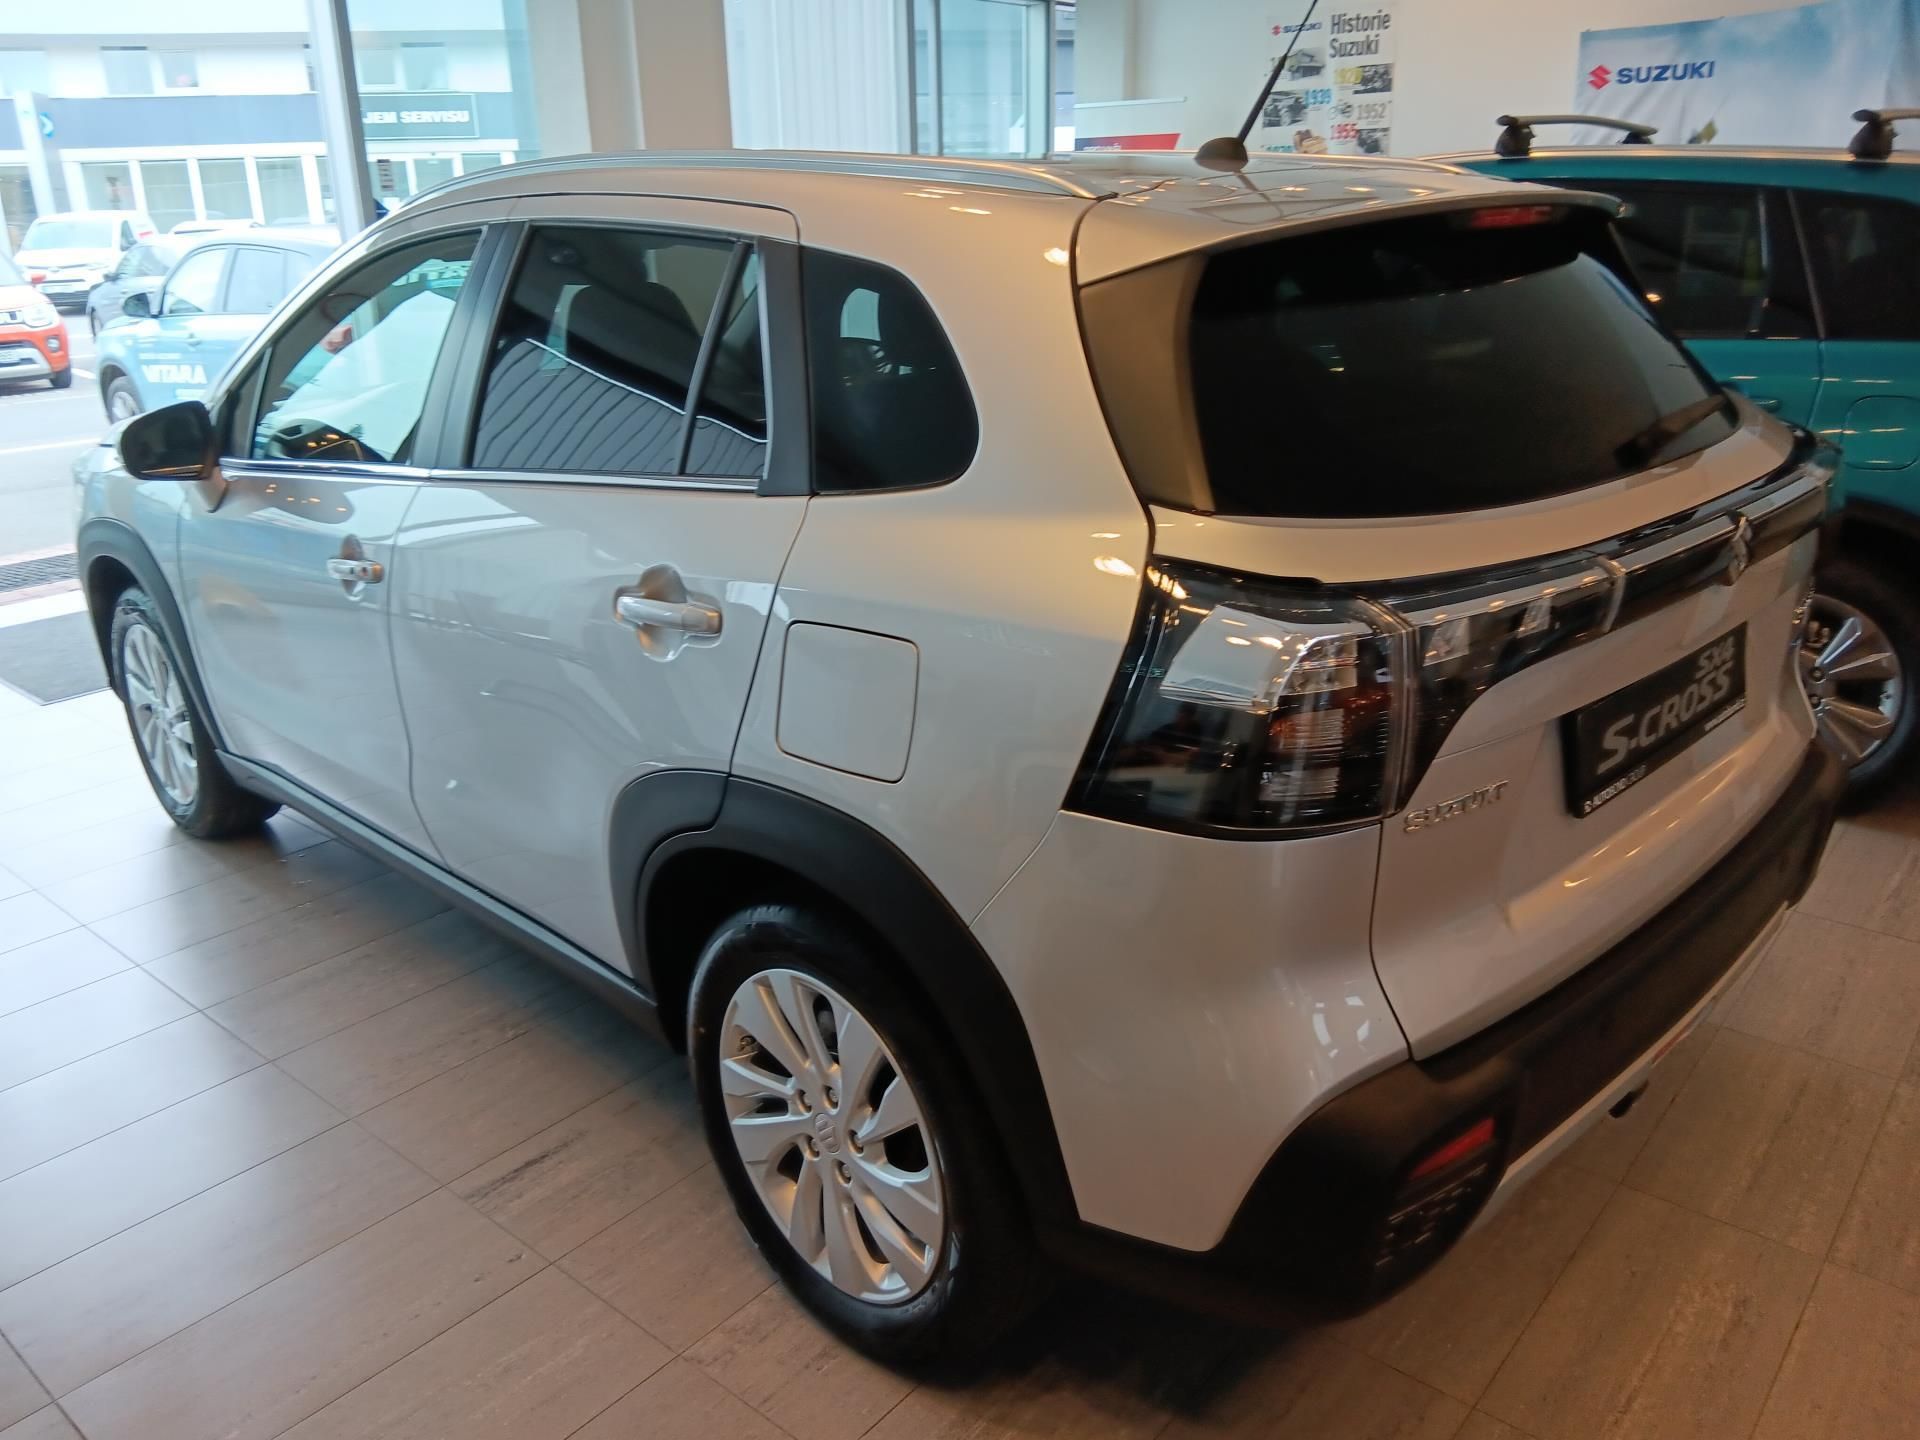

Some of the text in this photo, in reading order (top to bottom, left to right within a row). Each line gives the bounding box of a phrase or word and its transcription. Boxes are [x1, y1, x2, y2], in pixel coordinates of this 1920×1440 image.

[1330, 9, 1391, 35] Historie
[1329, 34, 1380, 58] Suzuki
[1616, 60, 1716, 85] SUZUKI
[399, 110, 470, 123] SERVISU
[1357, 102, 1386, 120] 1952
[141, 363, 208, 384] VITARA
